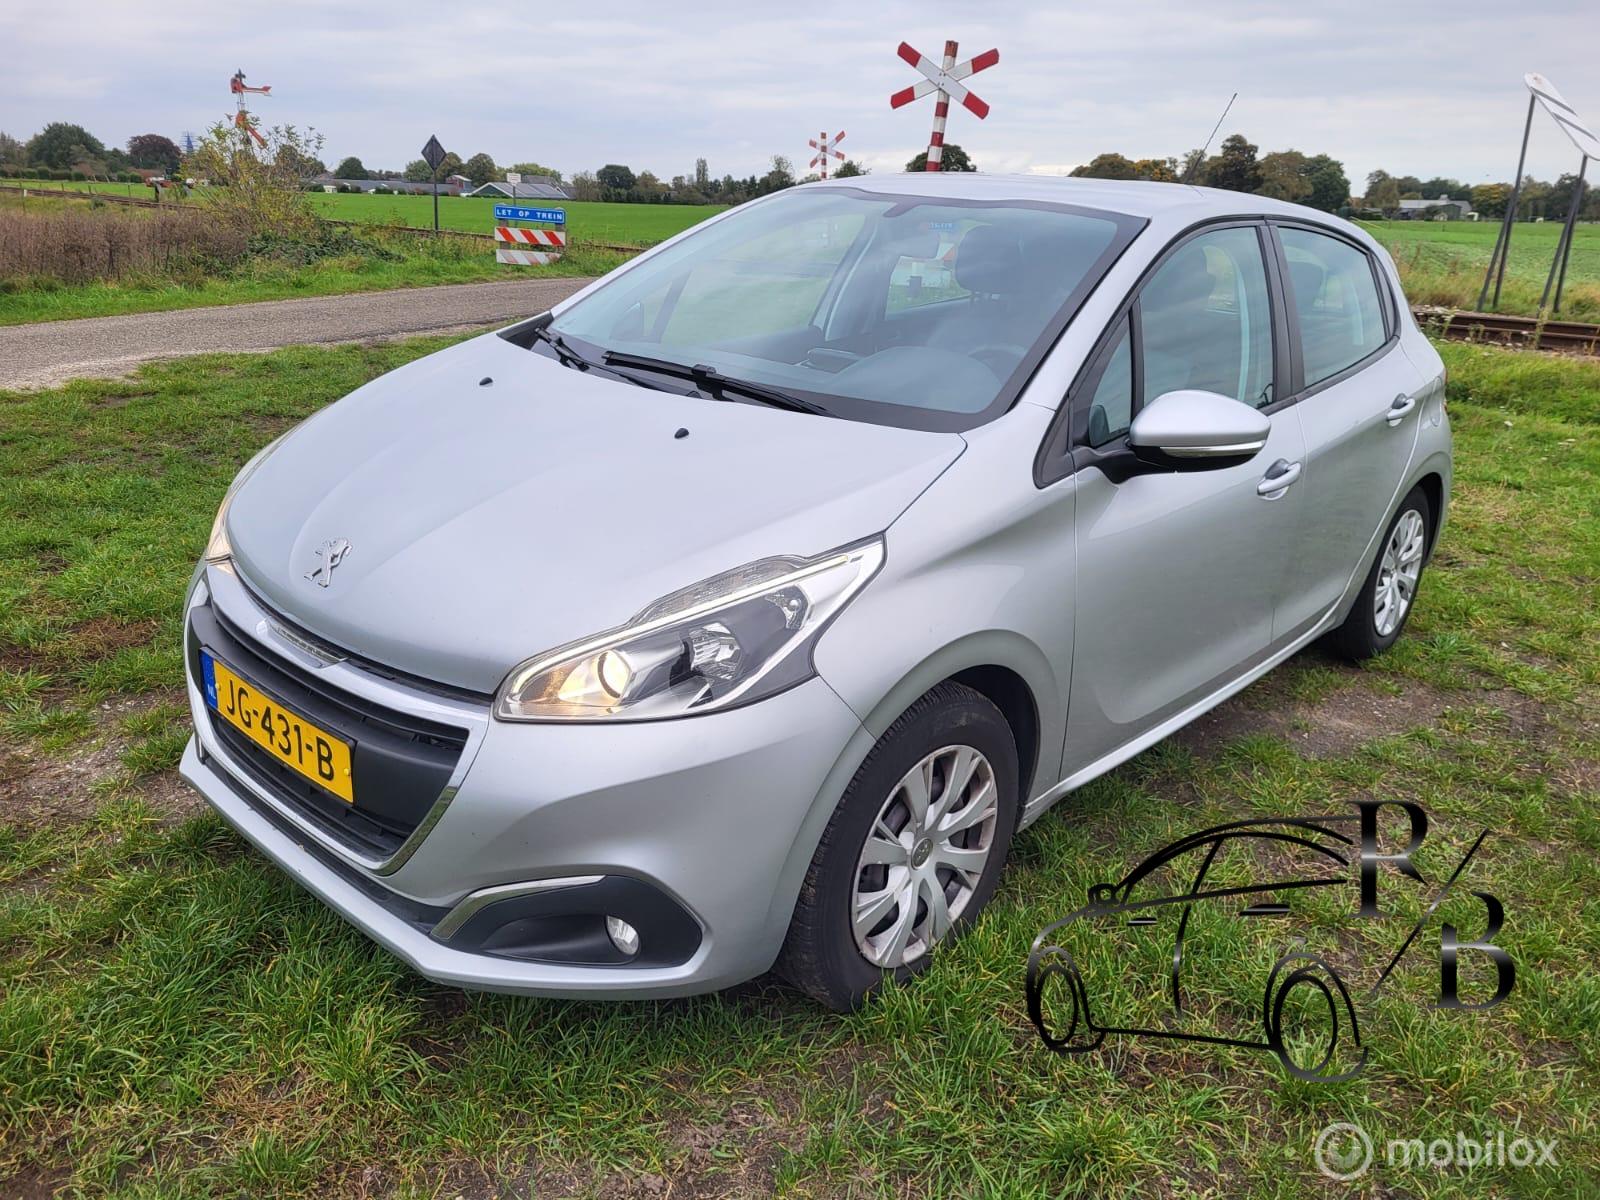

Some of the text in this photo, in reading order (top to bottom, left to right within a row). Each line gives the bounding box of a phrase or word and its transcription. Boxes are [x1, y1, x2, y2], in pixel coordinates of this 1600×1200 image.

[496, 208, 563, 220] LET OP TREIN
[227, 679, 335, 782] JG-431-B
